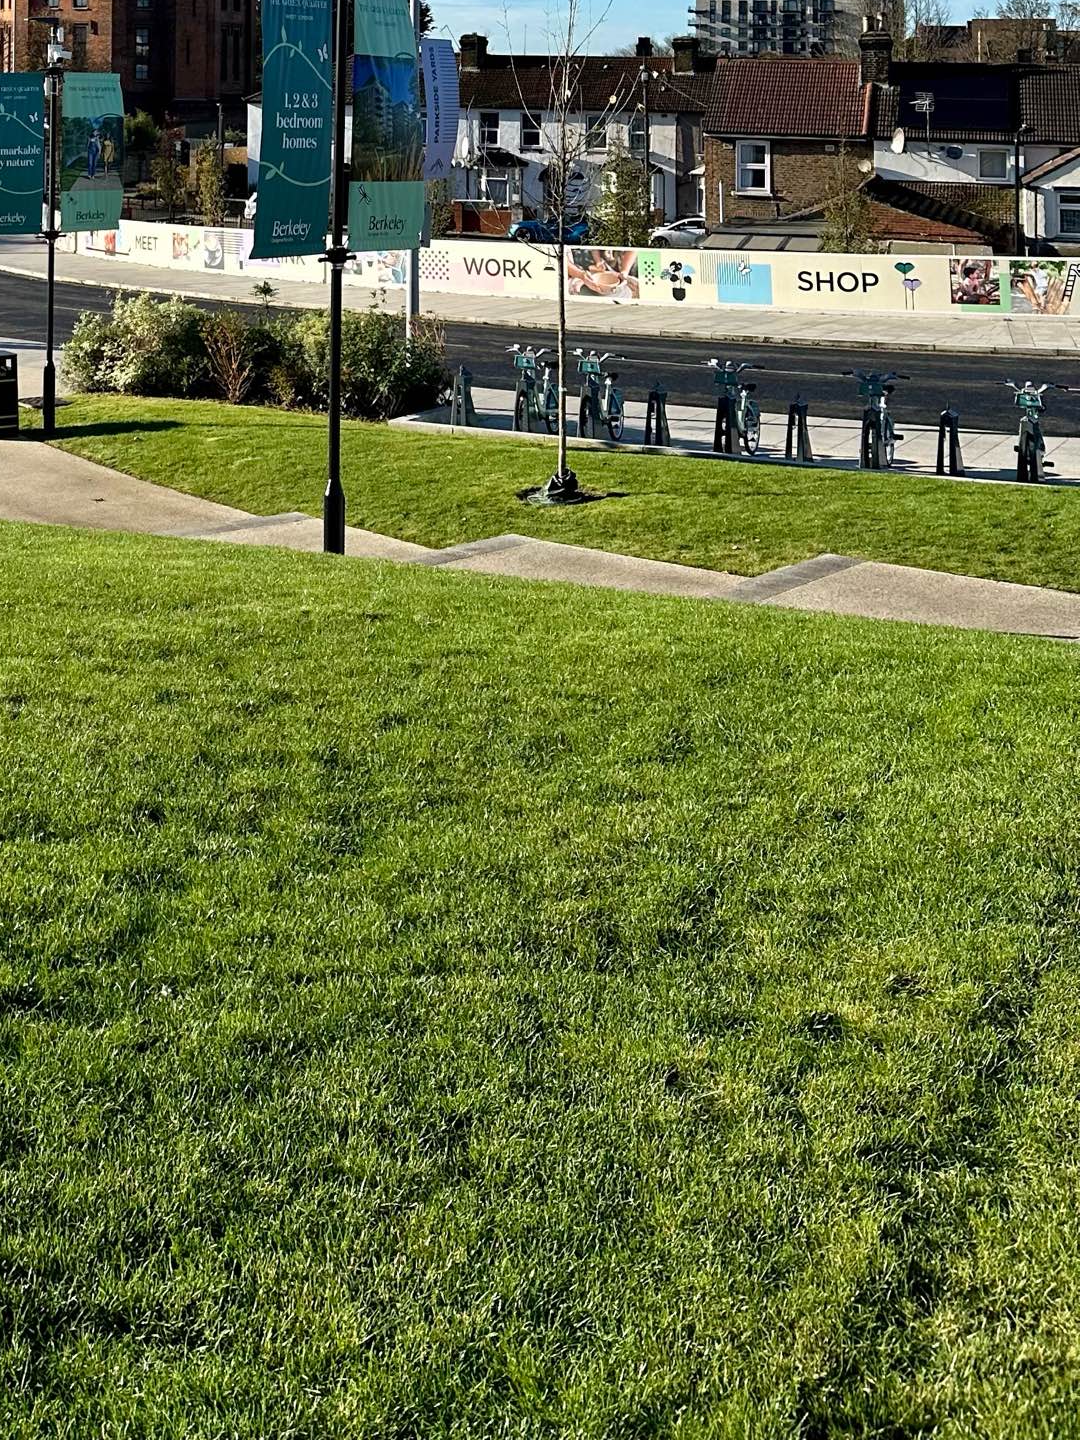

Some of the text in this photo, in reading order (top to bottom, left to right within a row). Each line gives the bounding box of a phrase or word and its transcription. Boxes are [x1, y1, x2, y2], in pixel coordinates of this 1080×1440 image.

[429, 46, 438, 82] YARDS
[276, 112, 323, 129] bedroom
[282, 132, 317, 149] homes
[6, 158, 35, 167] nature
[76, 210, 106, 222] Berkeley
[368, 215, 407, 235] Berkeley
[272, 218, 311, 241] Berkeley
[135, 235, 158, 252] MEET
[463, 257, 533, 279] WORK
[797, 271, 879, 293] SHOP
